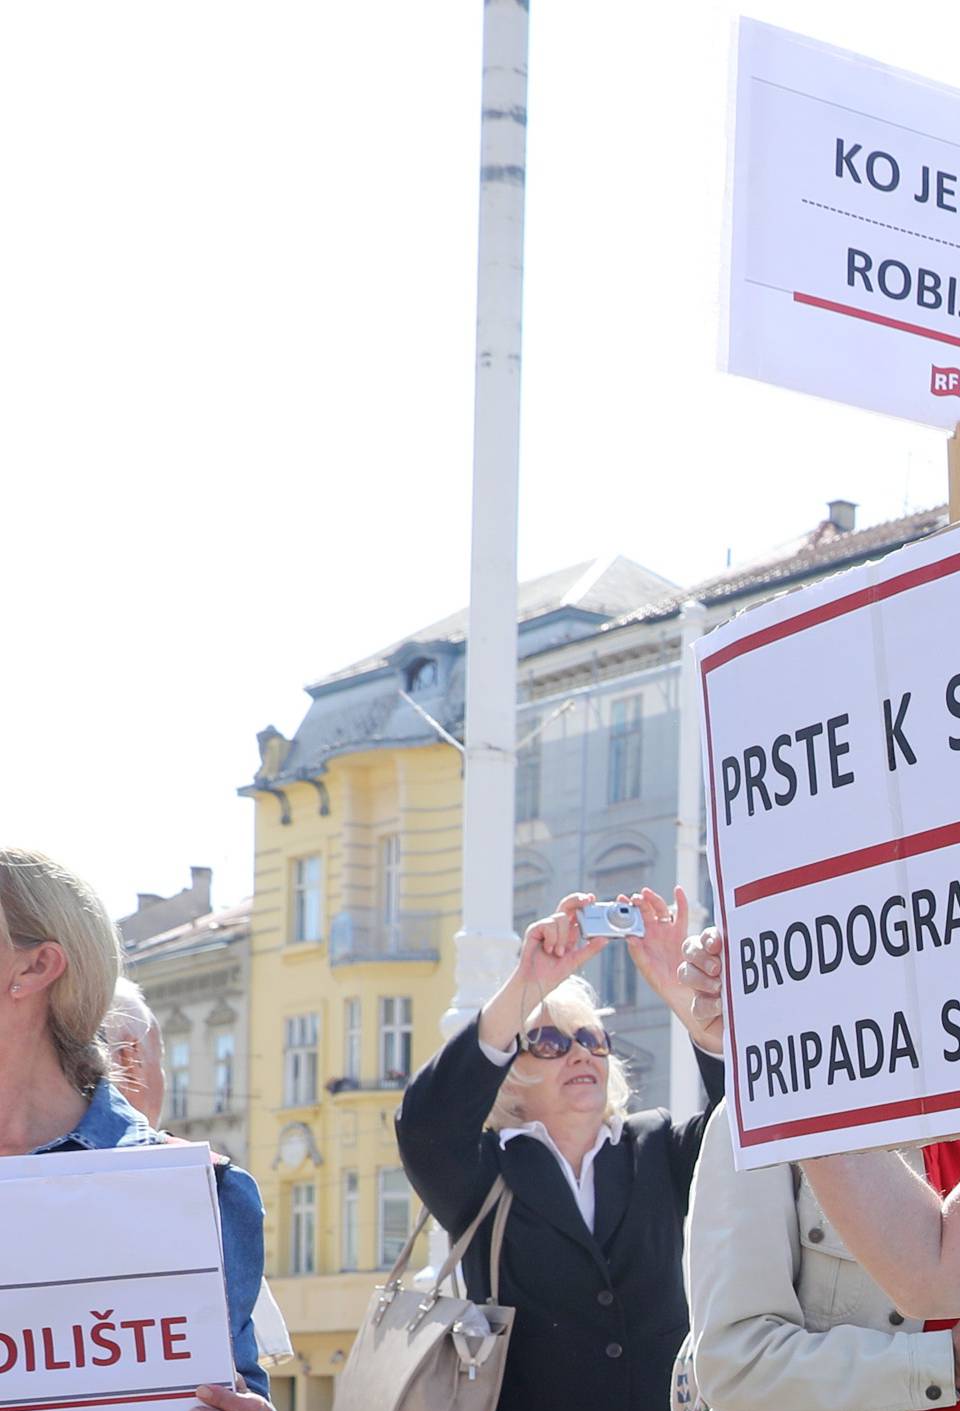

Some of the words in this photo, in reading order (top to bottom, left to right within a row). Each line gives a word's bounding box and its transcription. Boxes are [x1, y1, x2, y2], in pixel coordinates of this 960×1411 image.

[835, 137, 901, 193] KO
[914, 166, 957, 213] JE
[935, 373, 959, 391] RF
[722, 713, 855, 826] PRSTE
[884, 692, 917, 772] K
[746, 1010, 919, 1102] PRIPADA
